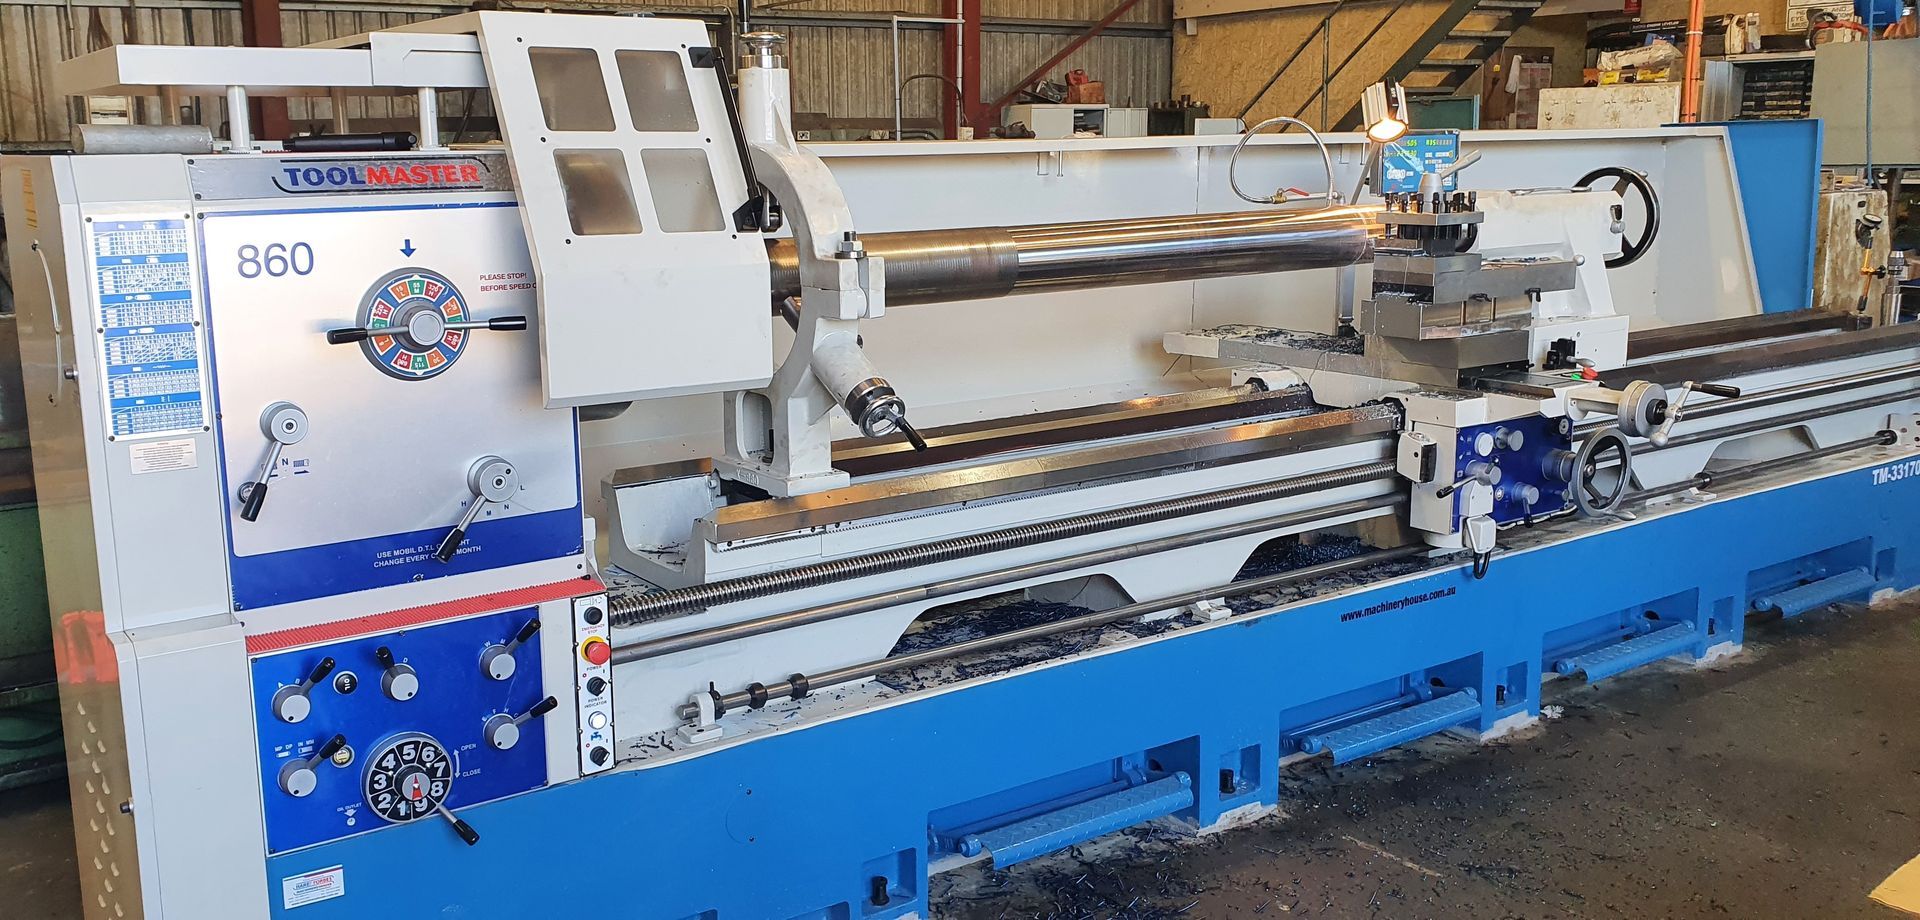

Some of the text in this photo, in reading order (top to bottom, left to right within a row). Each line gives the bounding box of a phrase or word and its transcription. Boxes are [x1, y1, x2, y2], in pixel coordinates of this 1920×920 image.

[283, 164, 480, 186] TOOLMASTER
[238, 242, 314, 278] 860
[1872, 460, 1920, 486] TM-33170
[394, 548, 416, 556] MOBIL
[456, 546, 481, 554] MONTH
[374, 558, 404, 568] CHANGE
[406, 554, 429, 562] EVERY
[1340, 586, 1456, 622] www.machineryhouse.com.au
[402, 744, 416, 760] 5
[422, 746, 435, 762] 6
[382, 754, 396, 769] 4
[434, 762, 446, 777] 7
[462, 768, 481, 777] CLOSE
[374, 774, 387, 790] 3
[431, 781, 444, 797] 8
[377, 794, 392, 809] 2
[397, 800, 406, 816] 1
[414, 798, 428, 812] 9
